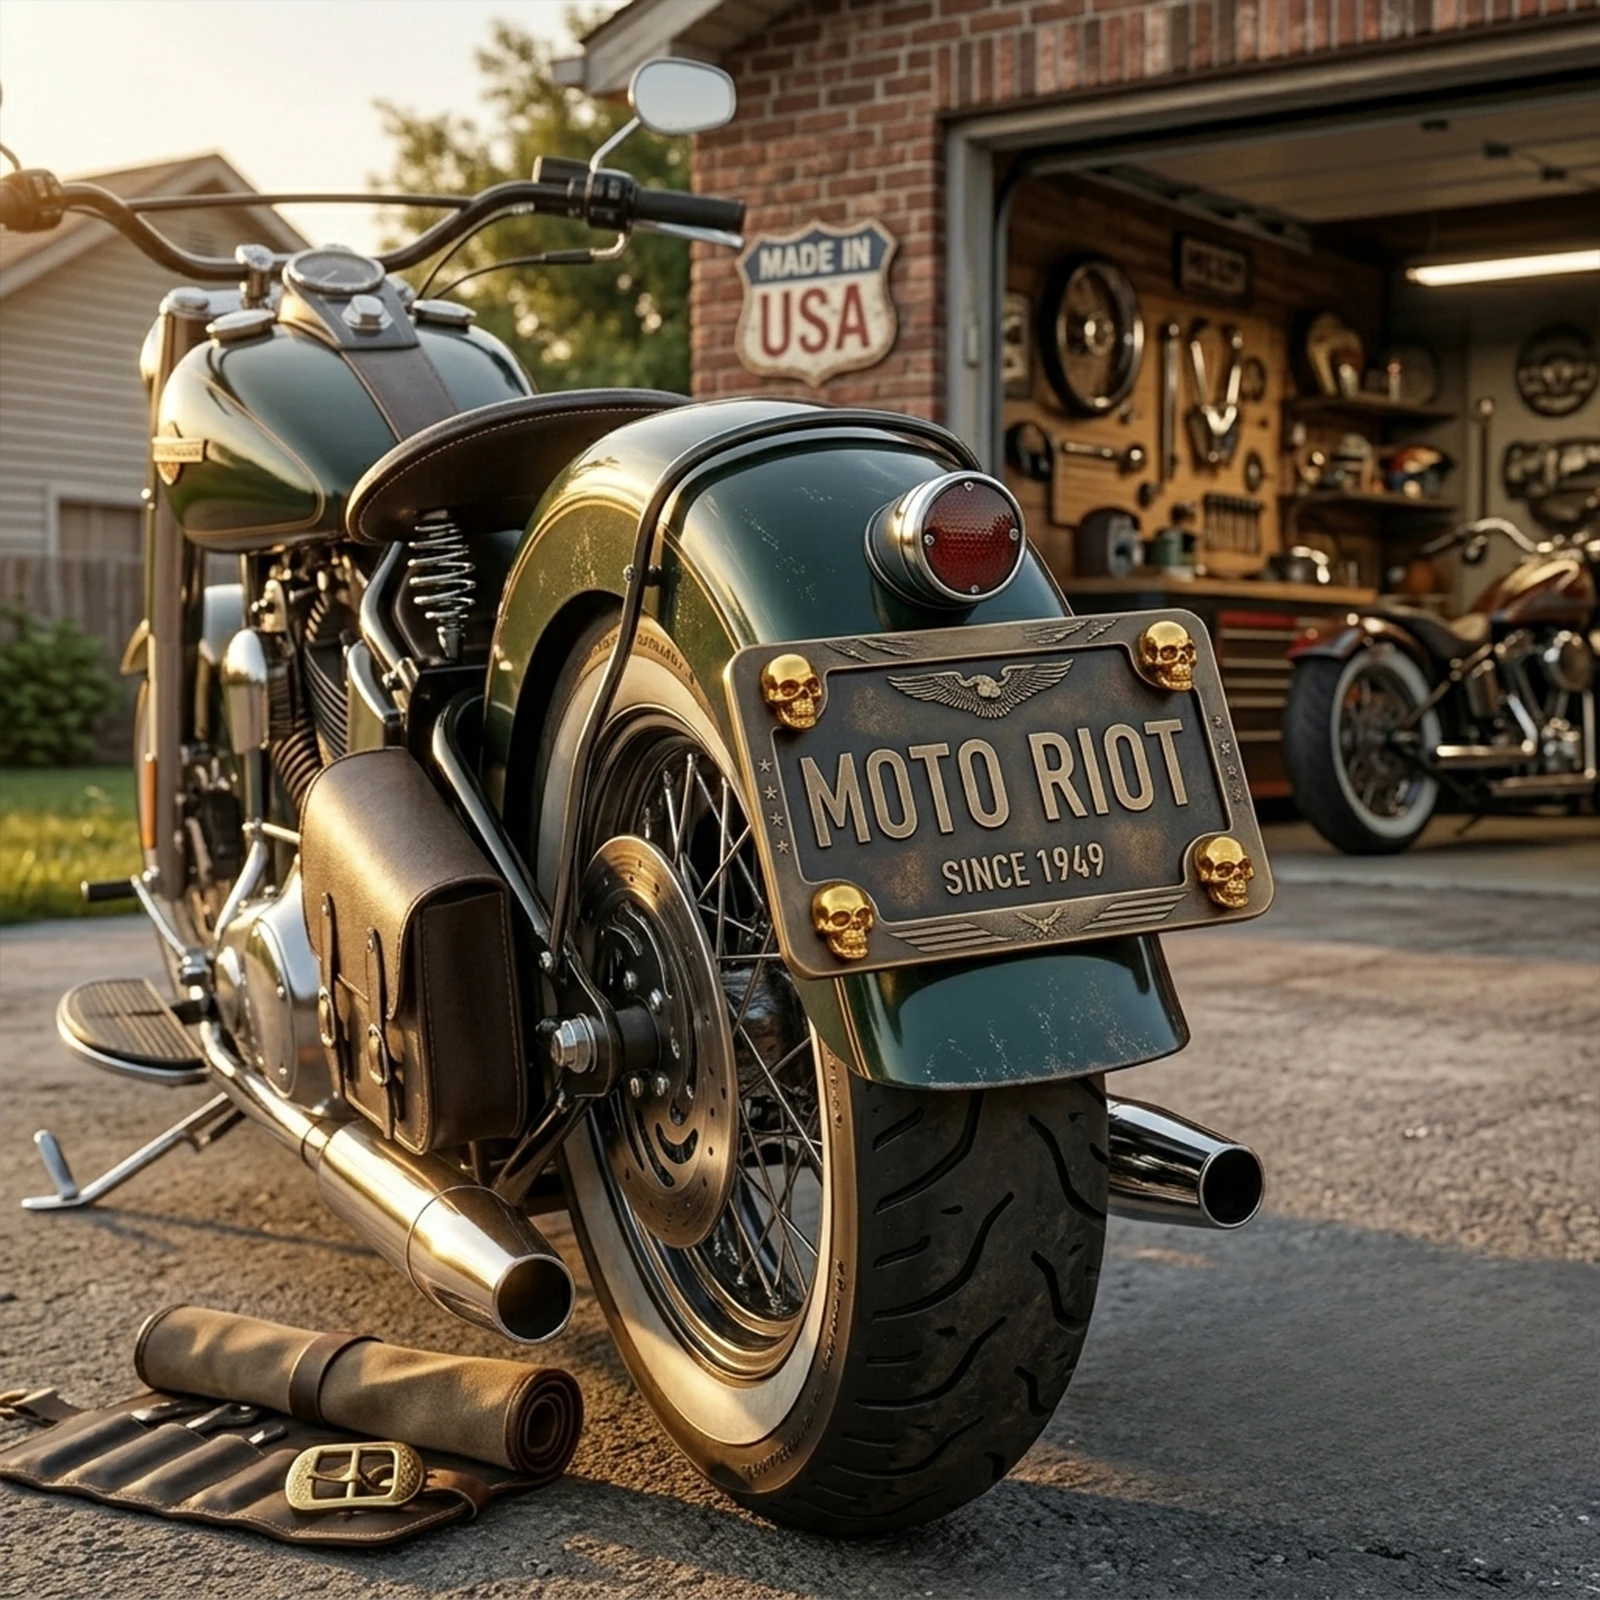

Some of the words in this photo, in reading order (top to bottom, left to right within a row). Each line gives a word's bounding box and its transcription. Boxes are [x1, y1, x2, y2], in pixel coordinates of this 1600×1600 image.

[759, 240, 834, 279] MADE
[842, 236, 871, 270] IN
[760, 283, 870, 357] USA
[800, 738, 1010, 848] MOTO
[1028, 718, 1189, 821] RIOT
[942, 851, 1030, 896] SINCE
[1036, 842, 1104, 883] 1949
